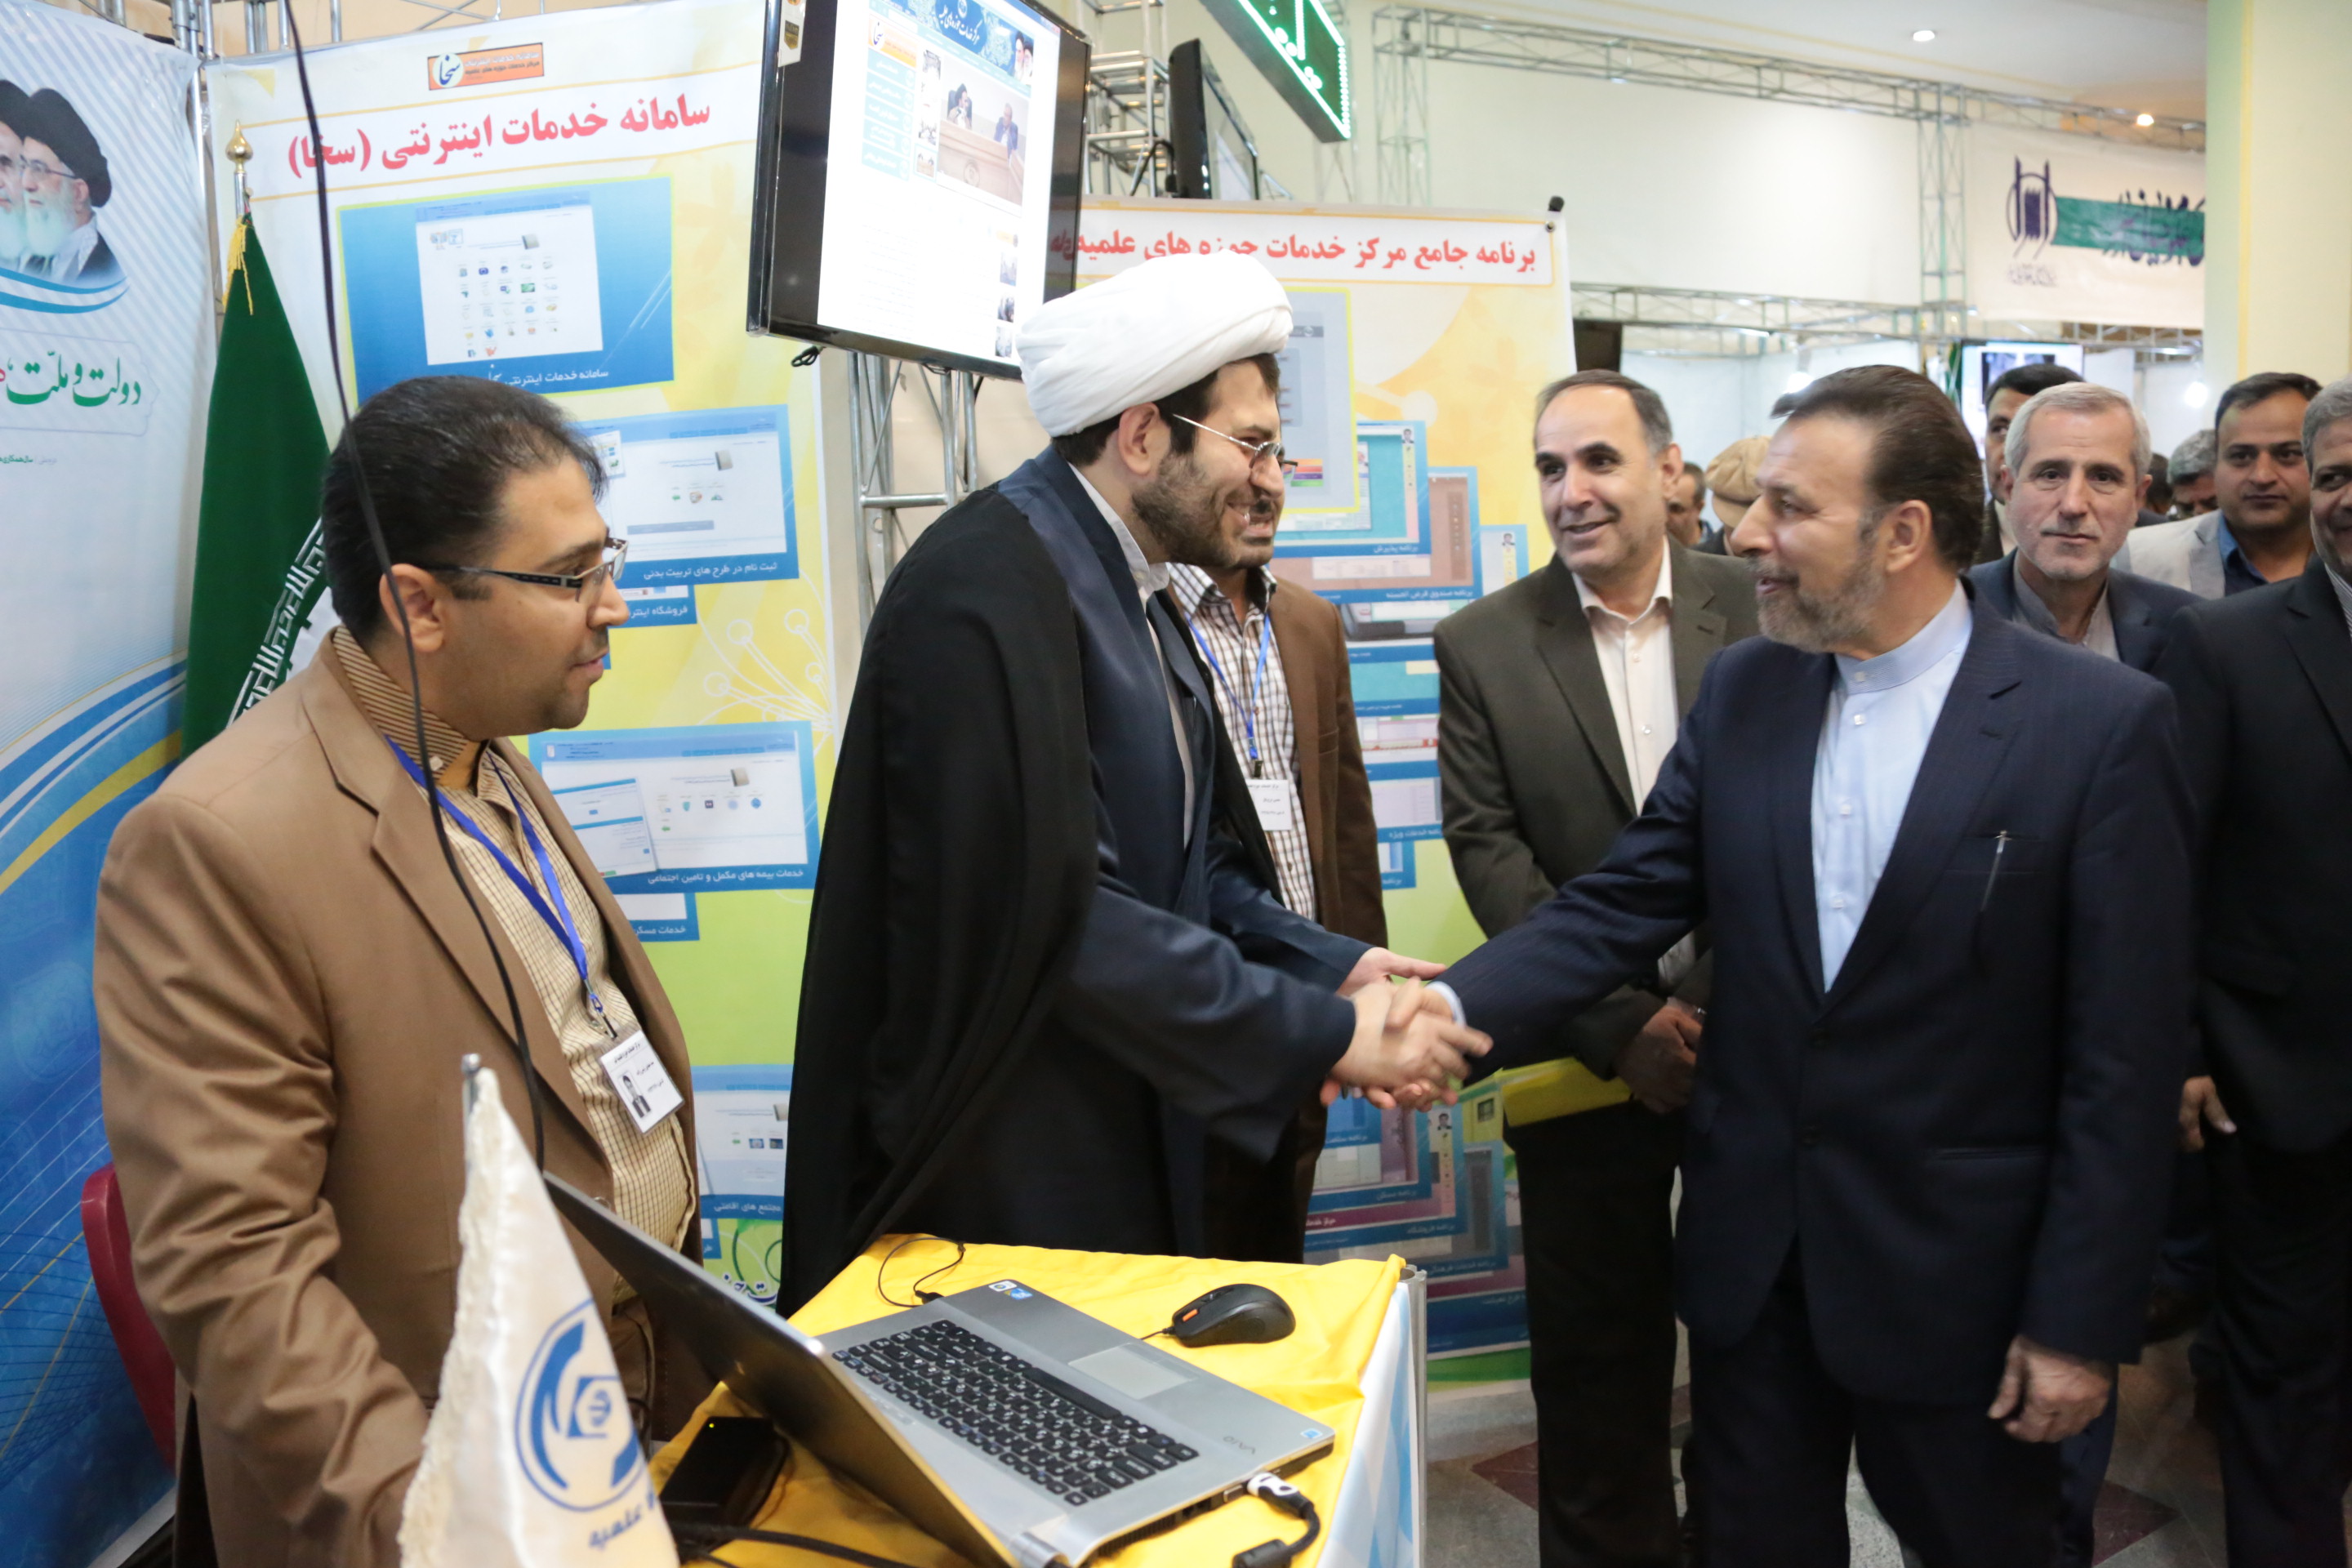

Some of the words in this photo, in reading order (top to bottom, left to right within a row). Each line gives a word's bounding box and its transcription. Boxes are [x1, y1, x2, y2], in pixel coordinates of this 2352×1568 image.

[501, 101, 608, 145] خدمات
[619, 93, 710, 133] سامانه
[381, 114, 492, 170] اینترنتی
[1077, 229, 1136, 261] علمیه
[1198, 237, 1259, 256] حوه
[1267, 234, 1346, 261] خدمات
[1353, 237, 1407, 270] مرکز
[1414, 240, 1468, 270] جامع
[1476, 240, 1537, 273] برنامه
[73, 356, 142, 408] دولت
[630, 607, 651, 619] اینتر
